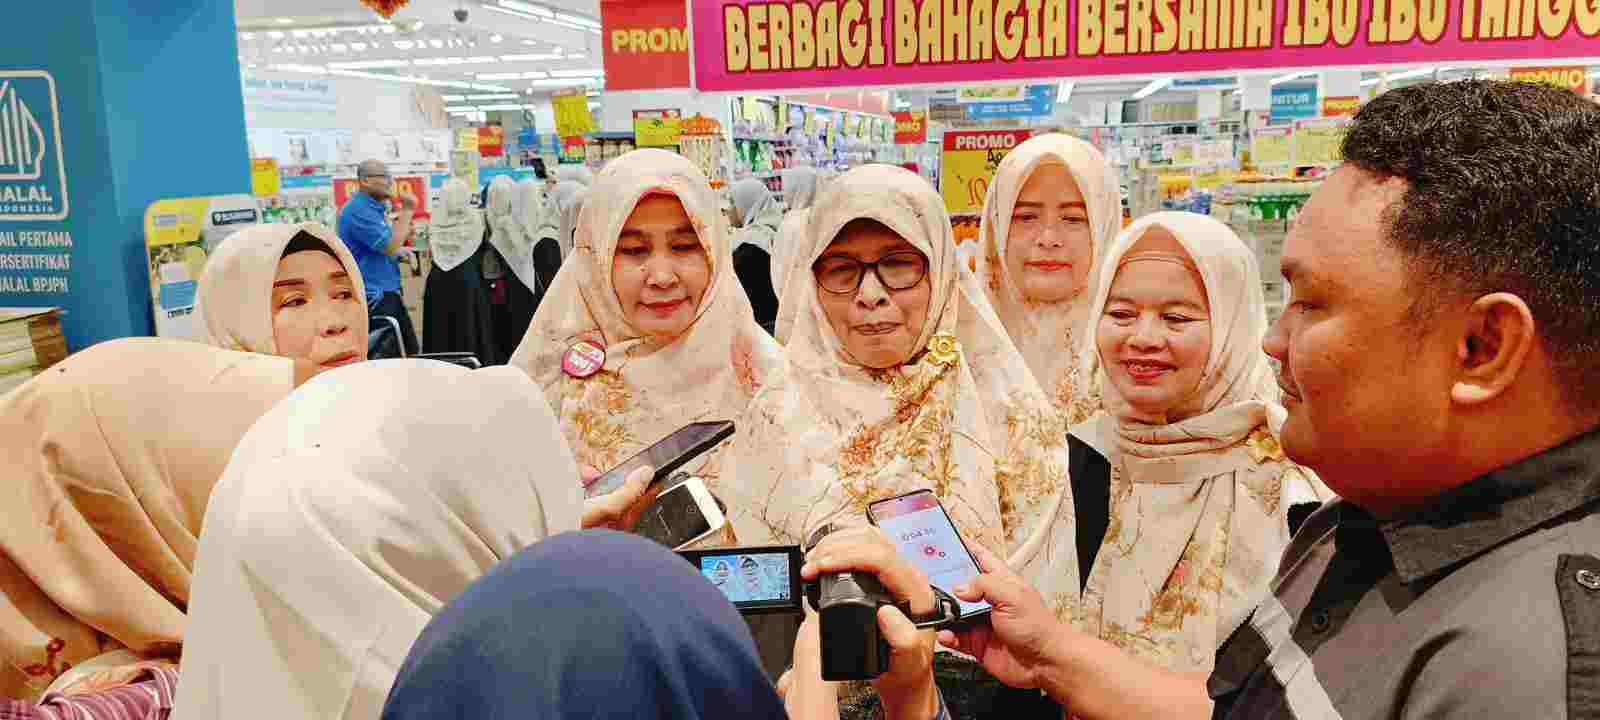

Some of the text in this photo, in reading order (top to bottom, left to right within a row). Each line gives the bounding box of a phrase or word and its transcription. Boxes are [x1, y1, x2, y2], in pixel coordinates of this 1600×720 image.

[724, 0, 886, 72] BERBAGI
[893, 0, 1069, 65] BAHAGIA
[1281, 0, 1357, 47] IBU
[1367, 0, 1447, 44] IBU
[955, 134, 1015, 150] PROMO
[18, 231, 72, 249] PERTAMA
